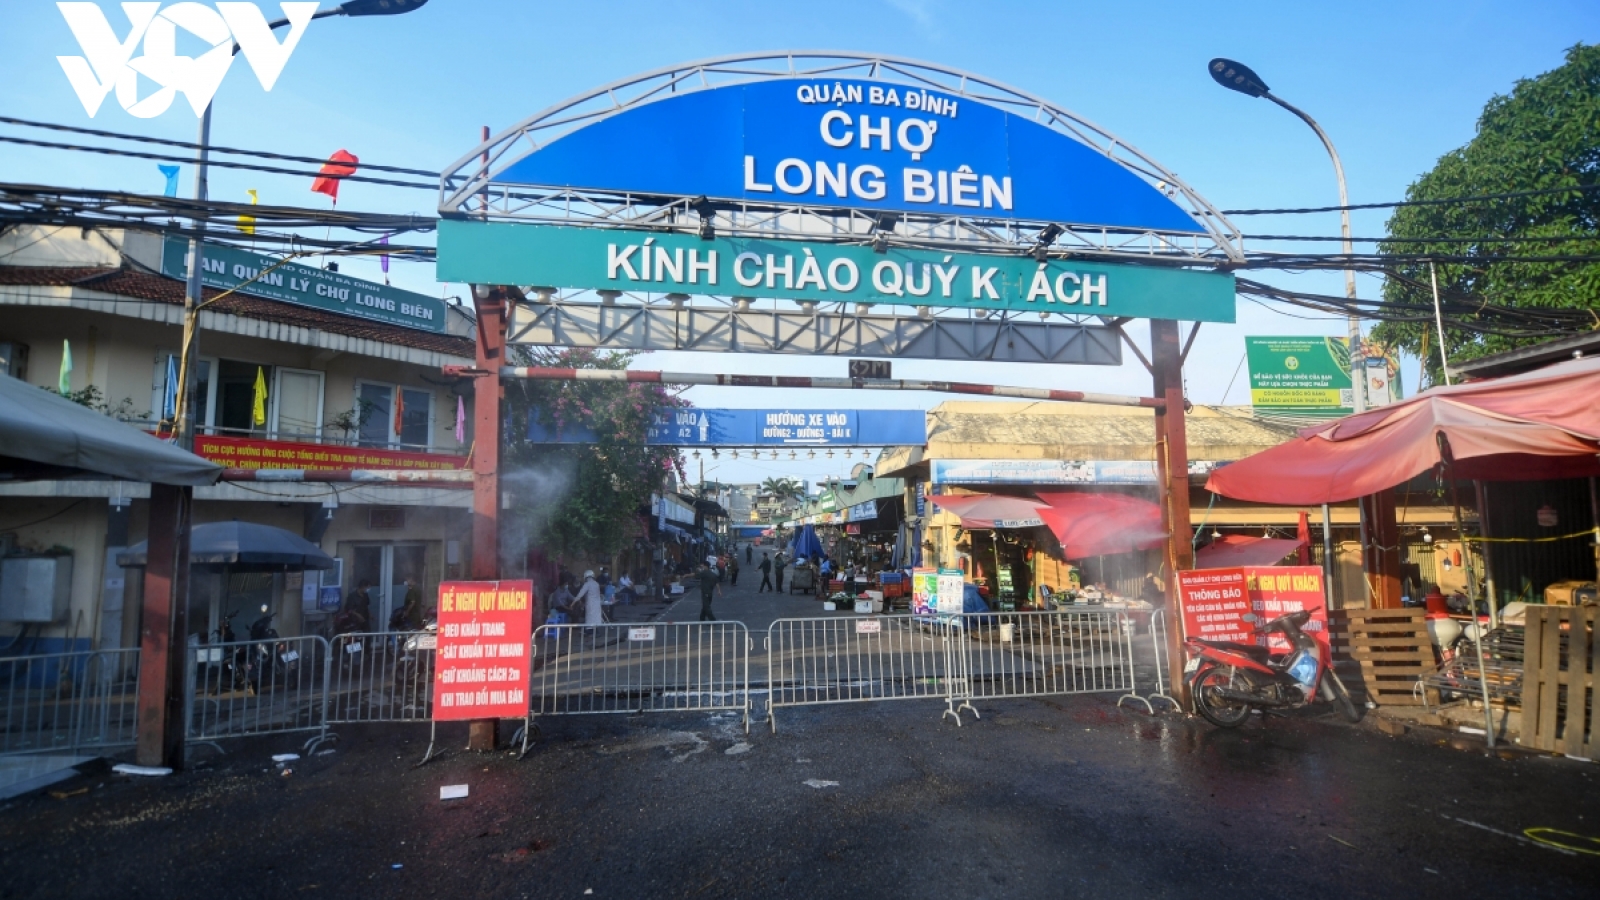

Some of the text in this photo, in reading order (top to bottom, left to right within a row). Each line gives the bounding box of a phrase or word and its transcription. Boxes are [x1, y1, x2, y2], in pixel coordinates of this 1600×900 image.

[797, 81, 958, 118] QUẬN BA ĐÌNH
[819, 109, 938, 161] CHỢ
[744, 155, 1013, 210] LONG BIÊN
[607, 236, 718, 285] KÍNH
[733, 246, 860, 292] CHÀO
[871, 254, 959, 298] QUÝ
[299, 268, 333, 282] QUẬN
[335, 277, 351, 286] BA
[353, 280, 380, 292] ĐÌNH
[290, 276, 311, 293] LÝ
[315, 283, 349, 303] CHỢ
[355, 292, 396, 312] LONG
[400, 303, 433, 321] BIÊN
[676, 409, 697, 426] VÀO
[766, 409, 848, 426] HƯỚNG XE VÀO
[678, 428, 692, 438] A2
[202, 443, 219, 454] TÍCH
[221, 445, 236, 456] CỰC
[1259, 575, 1276, 594] NGHỊ
[1276, 572, 1291, 594] QUÝ
[1292, 571, 1320, 592] KHÁCH
[456, 592, 477, 616] NGHỊ
[480, 588, 497, 613] QUÝ
[498, 587, 527, 611] KHÁCH
[1188, 586, 1241, 601] THÔNG BÁO
[1252, 596, 1304, 612] ĐEO KHẨU TRANG
[444, 617, 505, 637] ĐEO KHẨU TRANG
[443, 639, 524, 659] SÁT KHUẨN TAY NHANH
[442, 663, 520, 684] GIỮ KHOẢNG CÁCH 2m
[441, 686, 523, 707] KHI TRAO ĐỔI MUA BÁN
